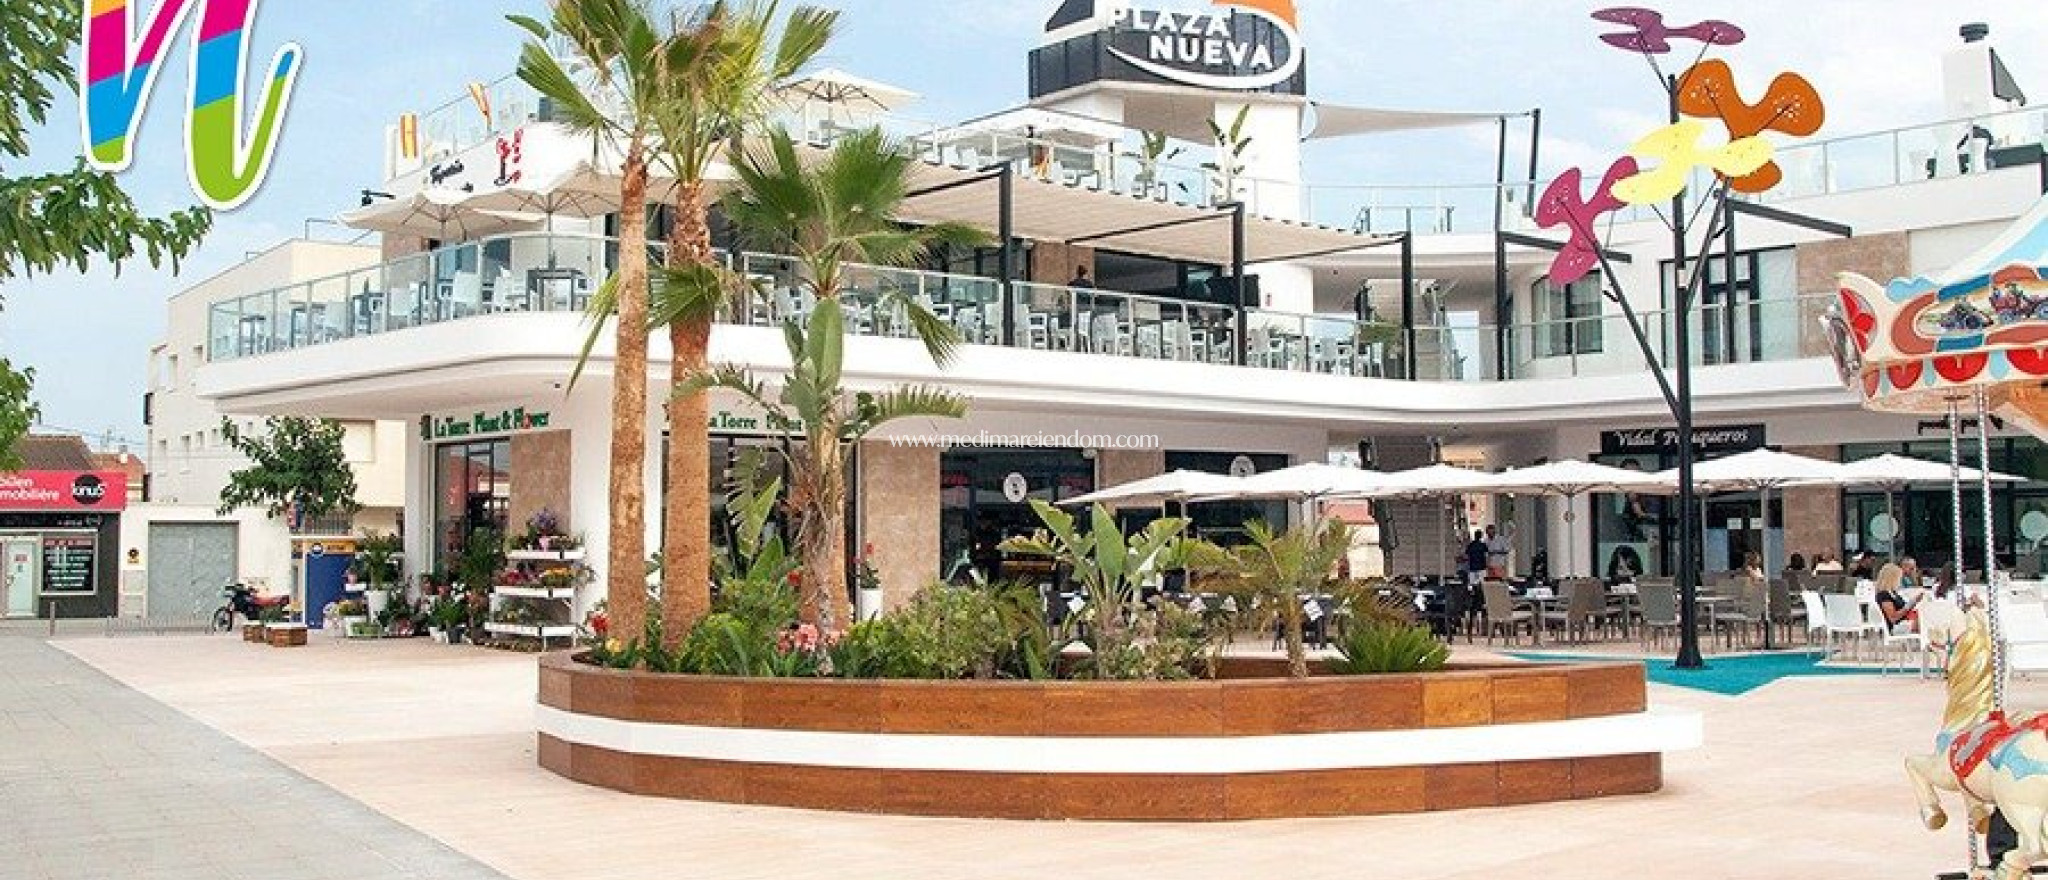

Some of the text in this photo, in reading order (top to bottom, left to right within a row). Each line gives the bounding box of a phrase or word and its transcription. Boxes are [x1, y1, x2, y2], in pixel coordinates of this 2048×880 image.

[1107, 6, 1231, 38] PLAZA
[1149, 34, 1274, 70] NUEVA
[719, 410, 757, 430] Torre
[1613, 428, 1660, 446] Vidal
